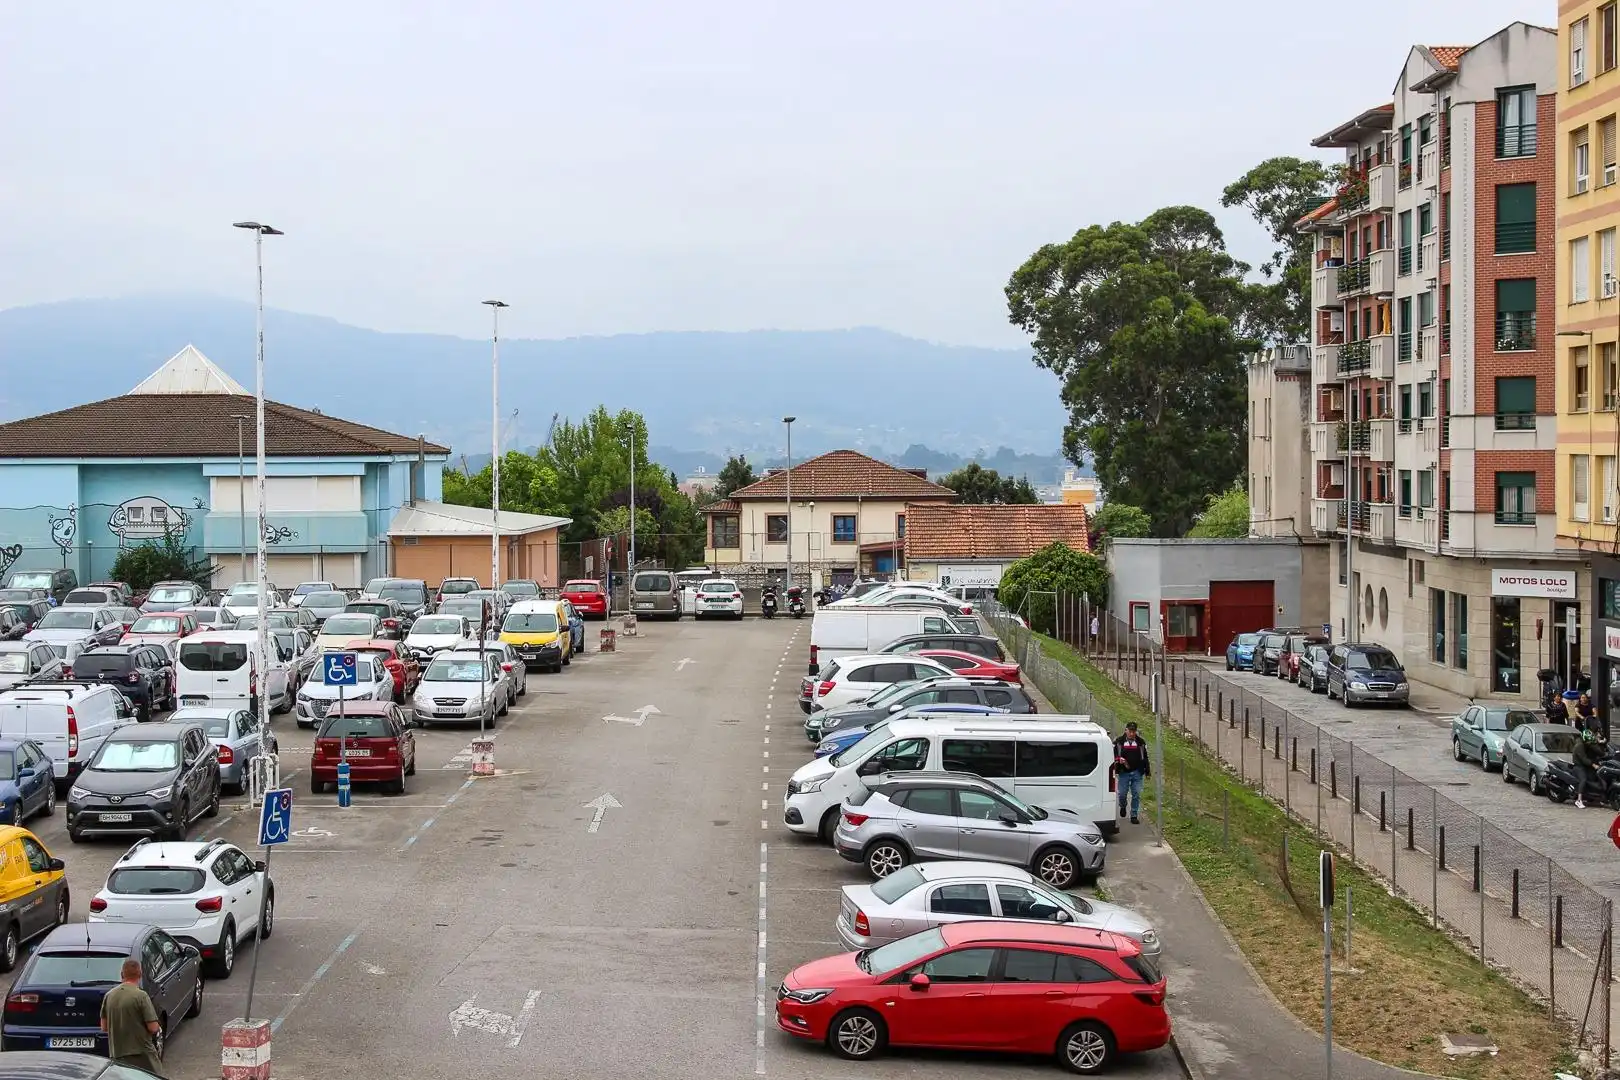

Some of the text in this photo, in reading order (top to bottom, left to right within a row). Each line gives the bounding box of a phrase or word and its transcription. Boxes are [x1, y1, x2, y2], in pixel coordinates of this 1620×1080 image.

[1499, 577, 1567, 586] MOTOS LOLO
[52, 1037, 93, 1048] 6725 BCY
